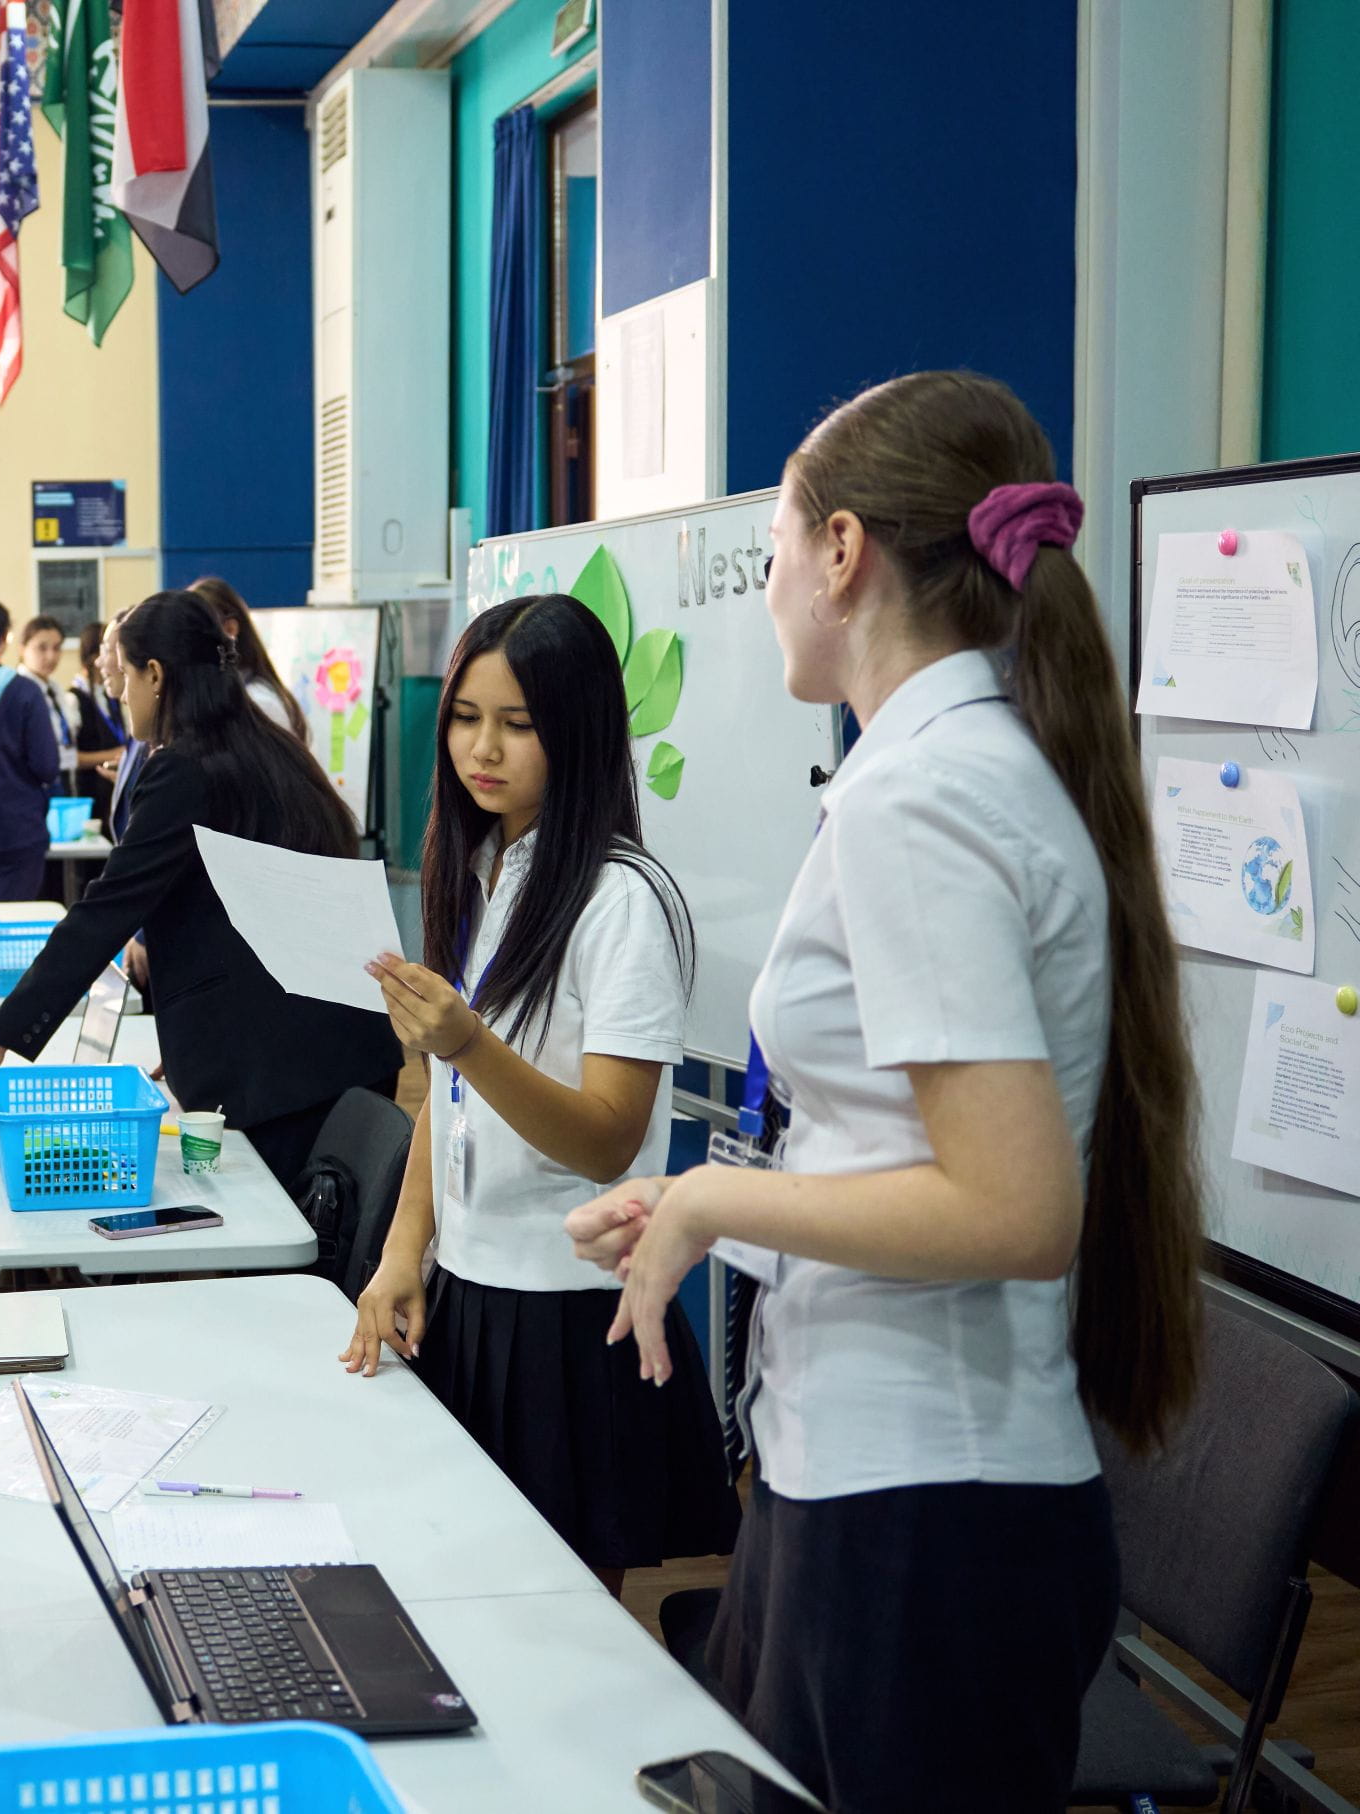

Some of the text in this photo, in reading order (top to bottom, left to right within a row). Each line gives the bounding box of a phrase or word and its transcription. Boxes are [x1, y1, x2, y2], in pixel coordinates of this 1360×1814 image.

[677, 525, 766, 607] Nest
[1280, 1023, 1295, 1034] Eco
[1296, 1027, 1323, 1042] Projects
[1280, 1034, 1302, 1047] Social
